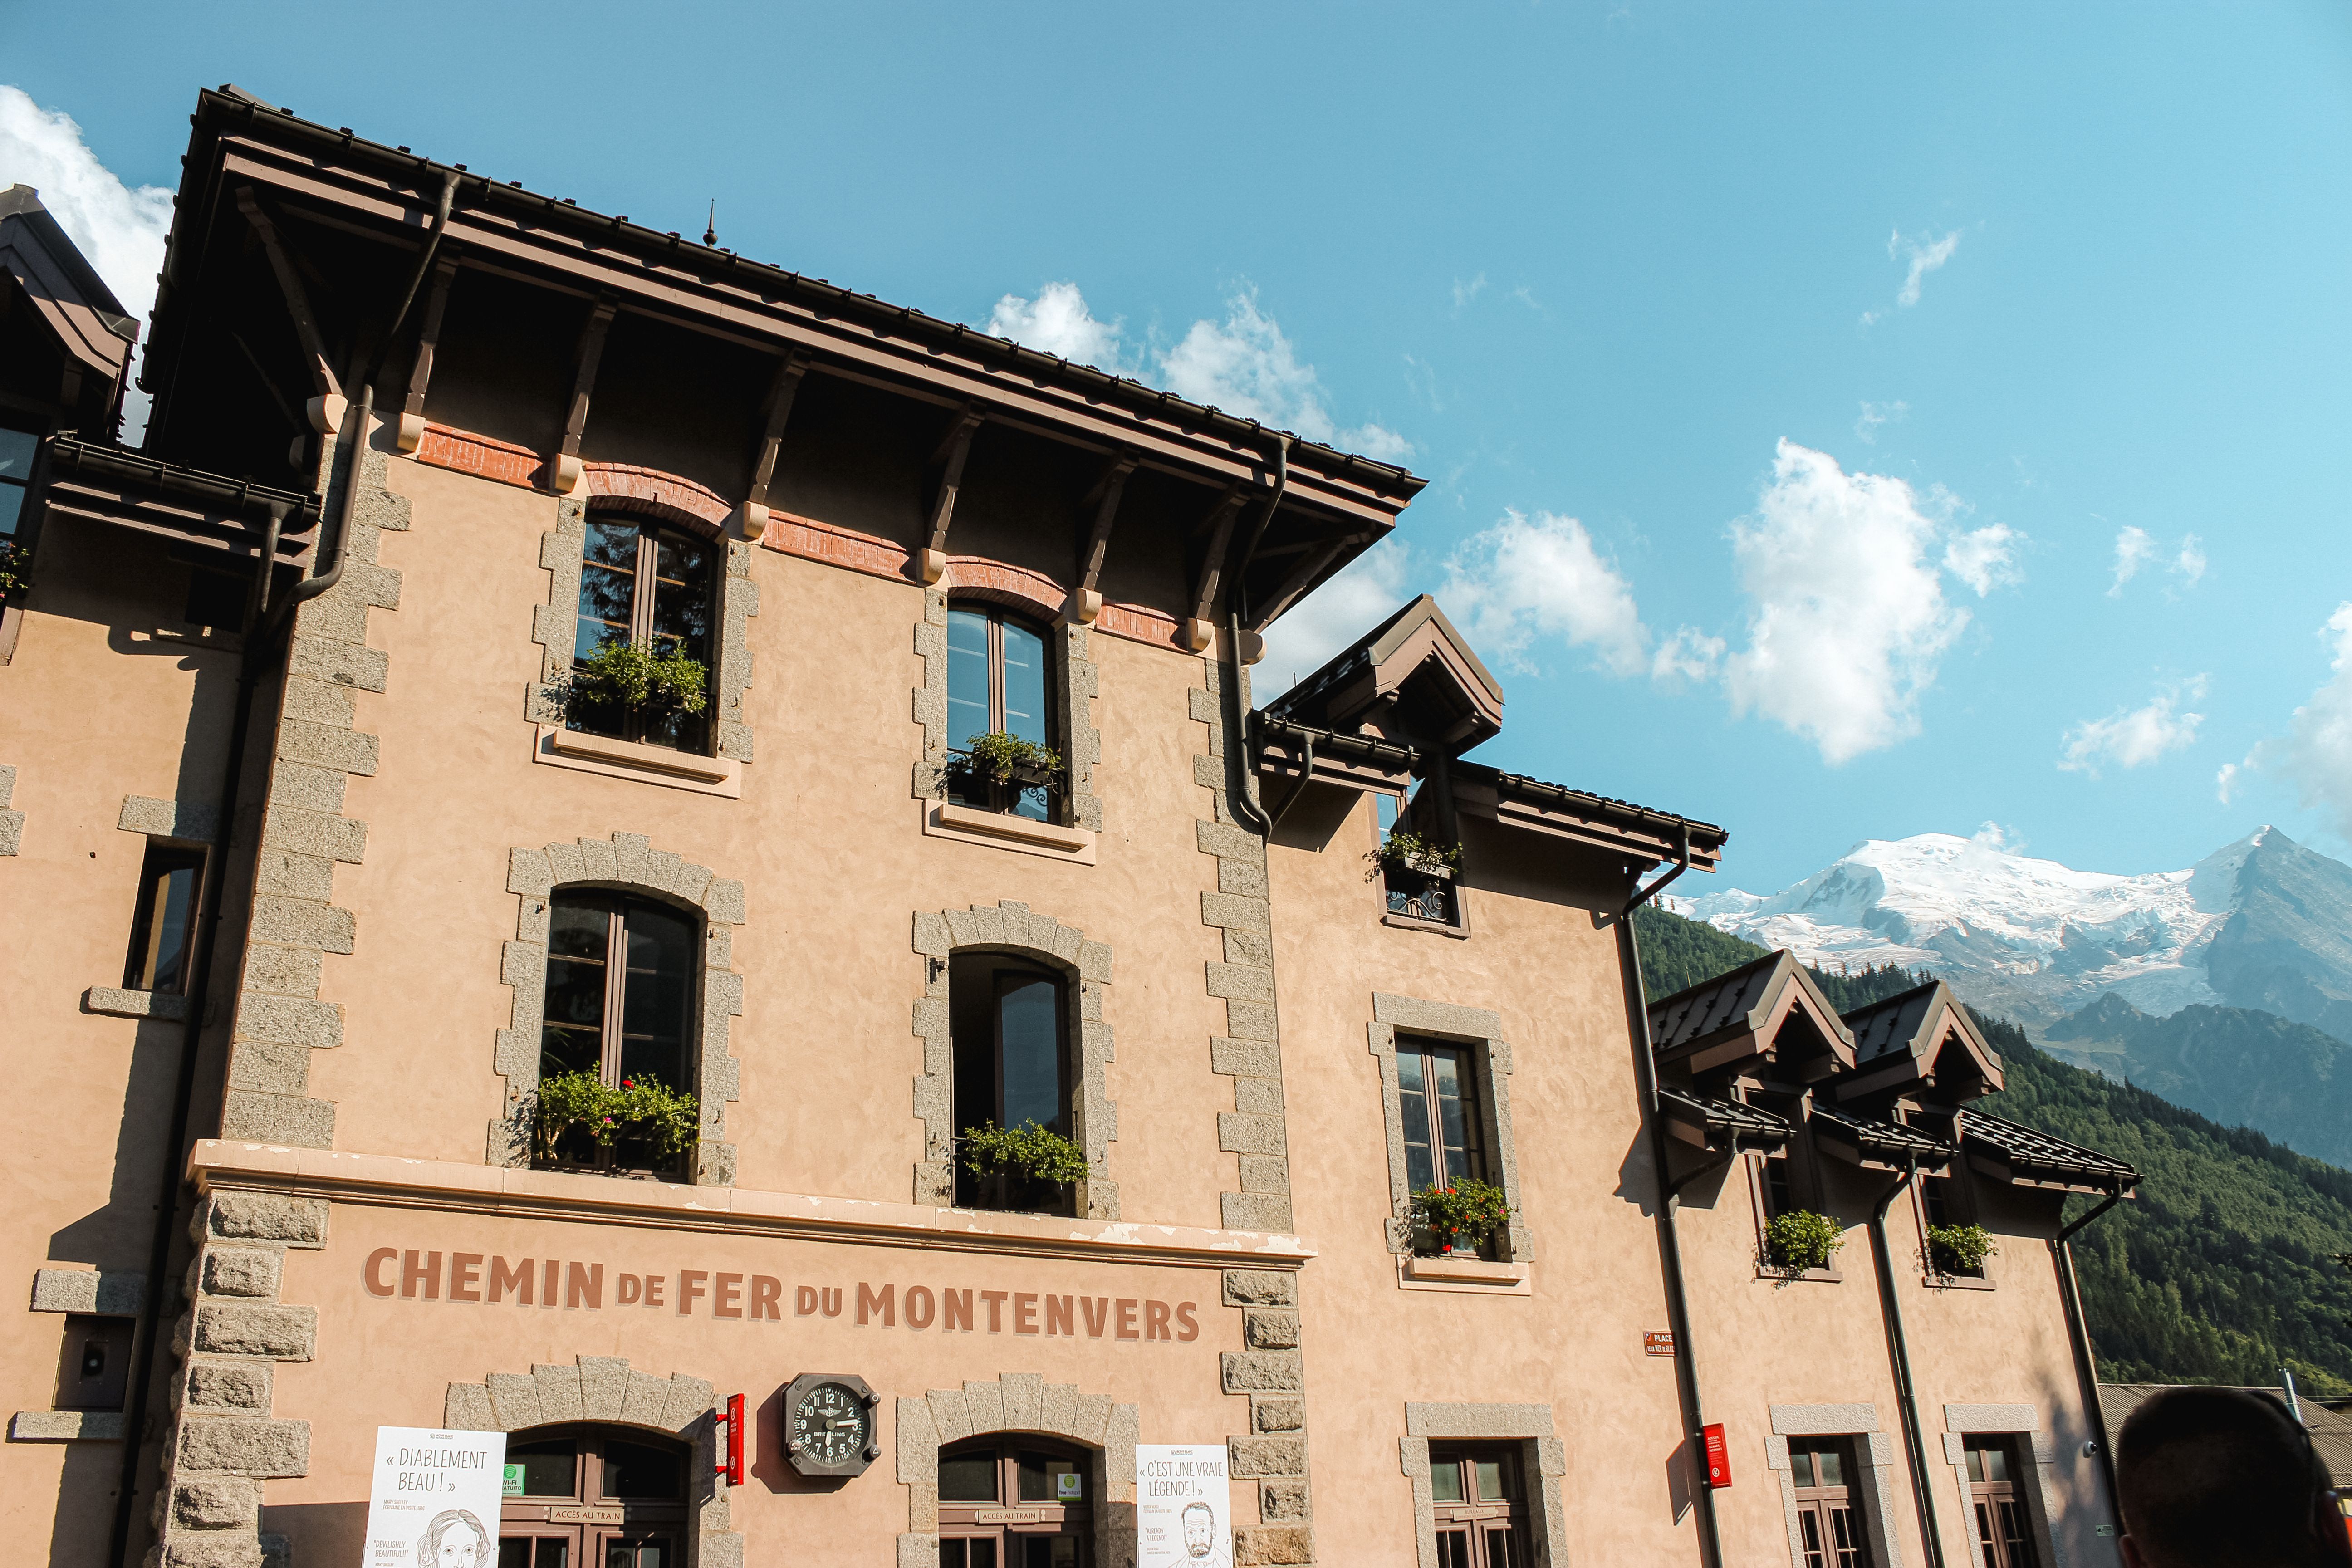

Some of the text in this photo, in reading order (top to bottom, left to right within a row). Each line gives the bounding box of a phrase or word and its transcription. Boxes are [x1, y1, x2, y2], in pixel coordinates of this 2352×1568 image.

[364, 1247, 1200, 1342] CHEMIN DE FER DU MONTENVERS
[814, 1396, 820, 1406] 11
[826, 1393, 835, 1404] 12
[841, 1396, 843, 1407] 1
[805, 1406, 814, 1416] 10
[848, 1407, 855, 1417] 2
[800, 1419, 807, 1430] 9
[804, 1433, 811, 1444] 8
[847, 1434, 854, 1445] 4
[815, 1443, 822, 1453] 7
[826, 1446, 833, 1457] 6
[839, 1443, 846, 1454] 5
[399, 1448, 487, 1469] DIABLEMENT
[1148, 1460, 1173, 1477] C'EST
[1175, 1462, 1195, 1477] UNE
[1196, 1462, 1223, 1477] VRAIE
[398, 1472, 435, 1491] BEAU
[1149, 1479, 1190, 1496] LÉGENDE
[555, 1510, 580, 1518] ACCÈS
[983, 1510, 1003, 1519] ACCÈS
